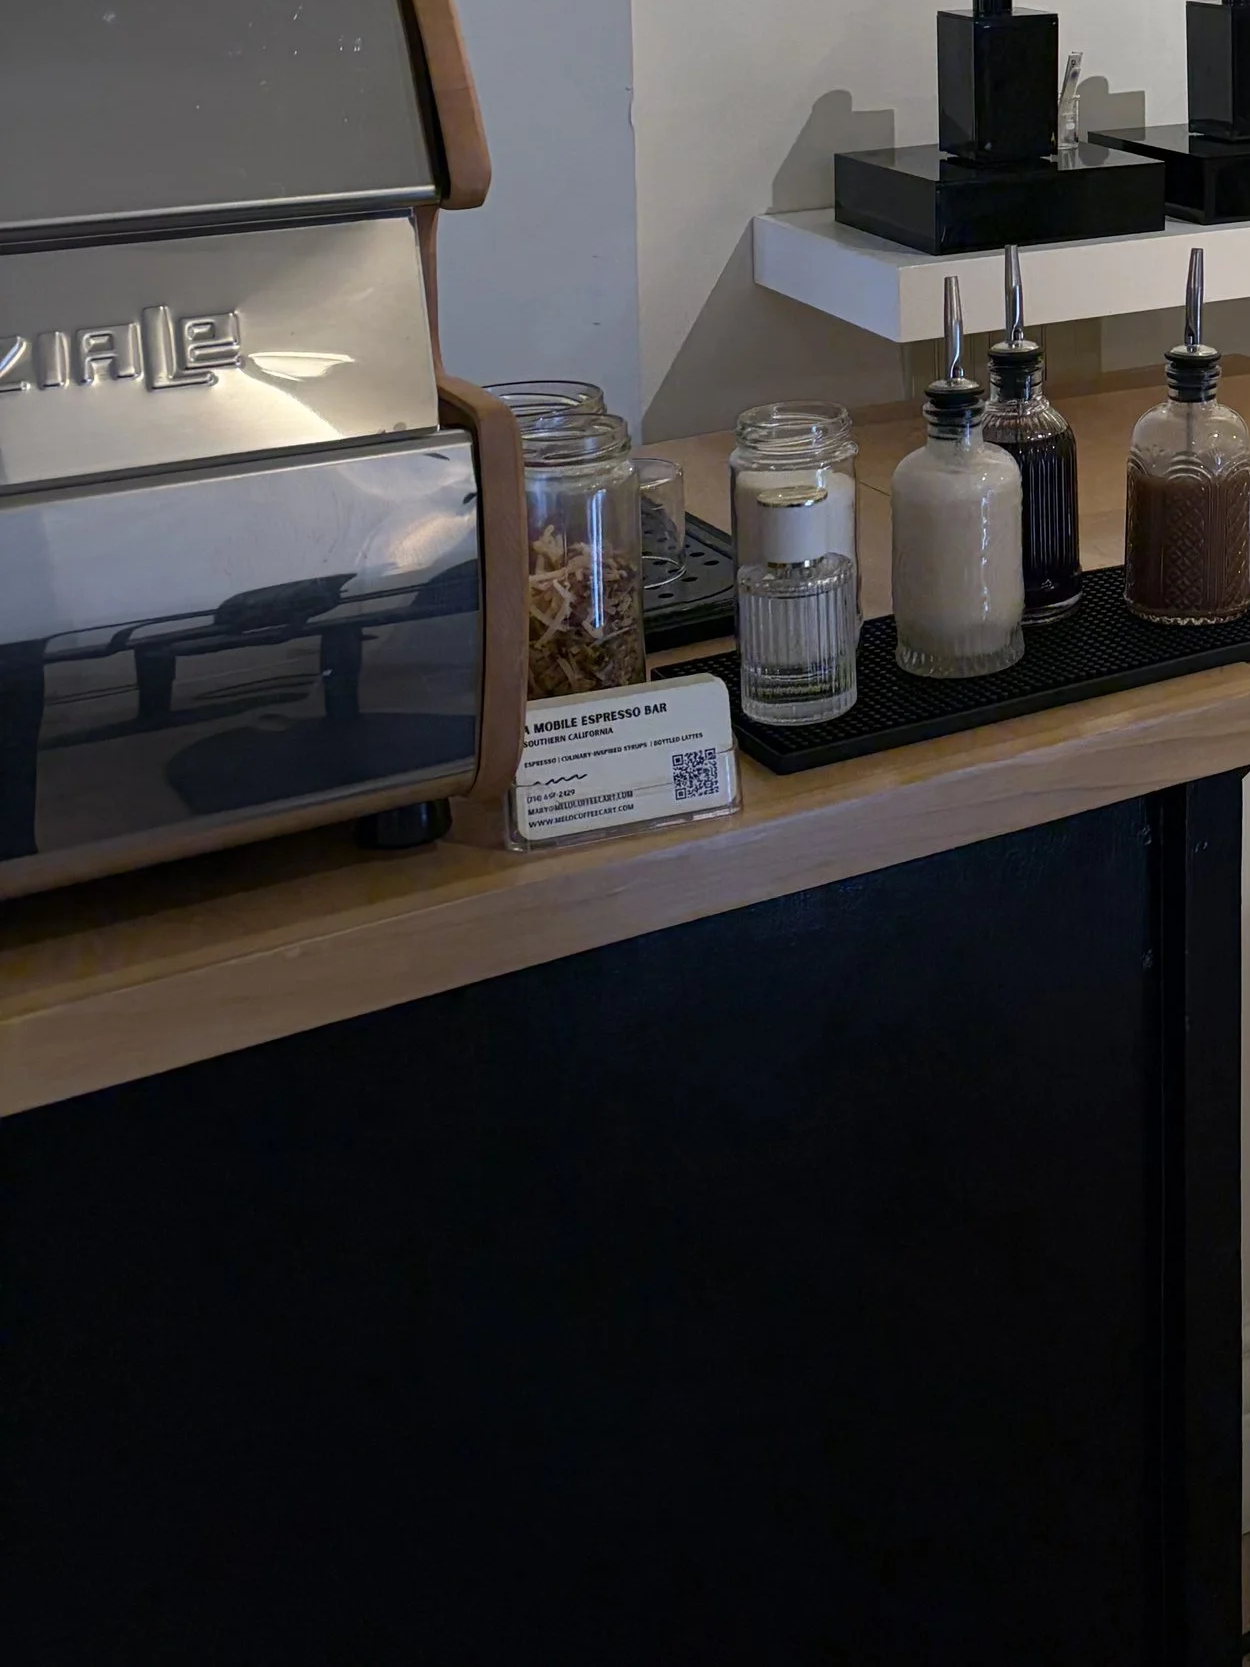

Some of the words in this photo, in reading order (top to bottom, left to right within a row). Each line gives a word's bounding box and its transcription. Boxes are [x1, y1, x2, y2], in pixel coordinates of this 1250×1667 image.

[524, 725, 530, 735] A
[534, 718, 577, 733] MOBILE
[581, 707, 641, 726] ESPRESSO
[645, 703, 667, 715] BAR
[523, 735, 566, 748] SOUTHERN
[568, 727, 614, 741] CALIFORNIA
[524, 758, 557, 769] ESPRESSO
[561, 747, 622, 762] CULINARY-INSPIRED
[624, 742, 647, 752] SYRUPS
[654, 736, 681, 747] BOTTLED
[682, 732, 703, 742] LATTES
